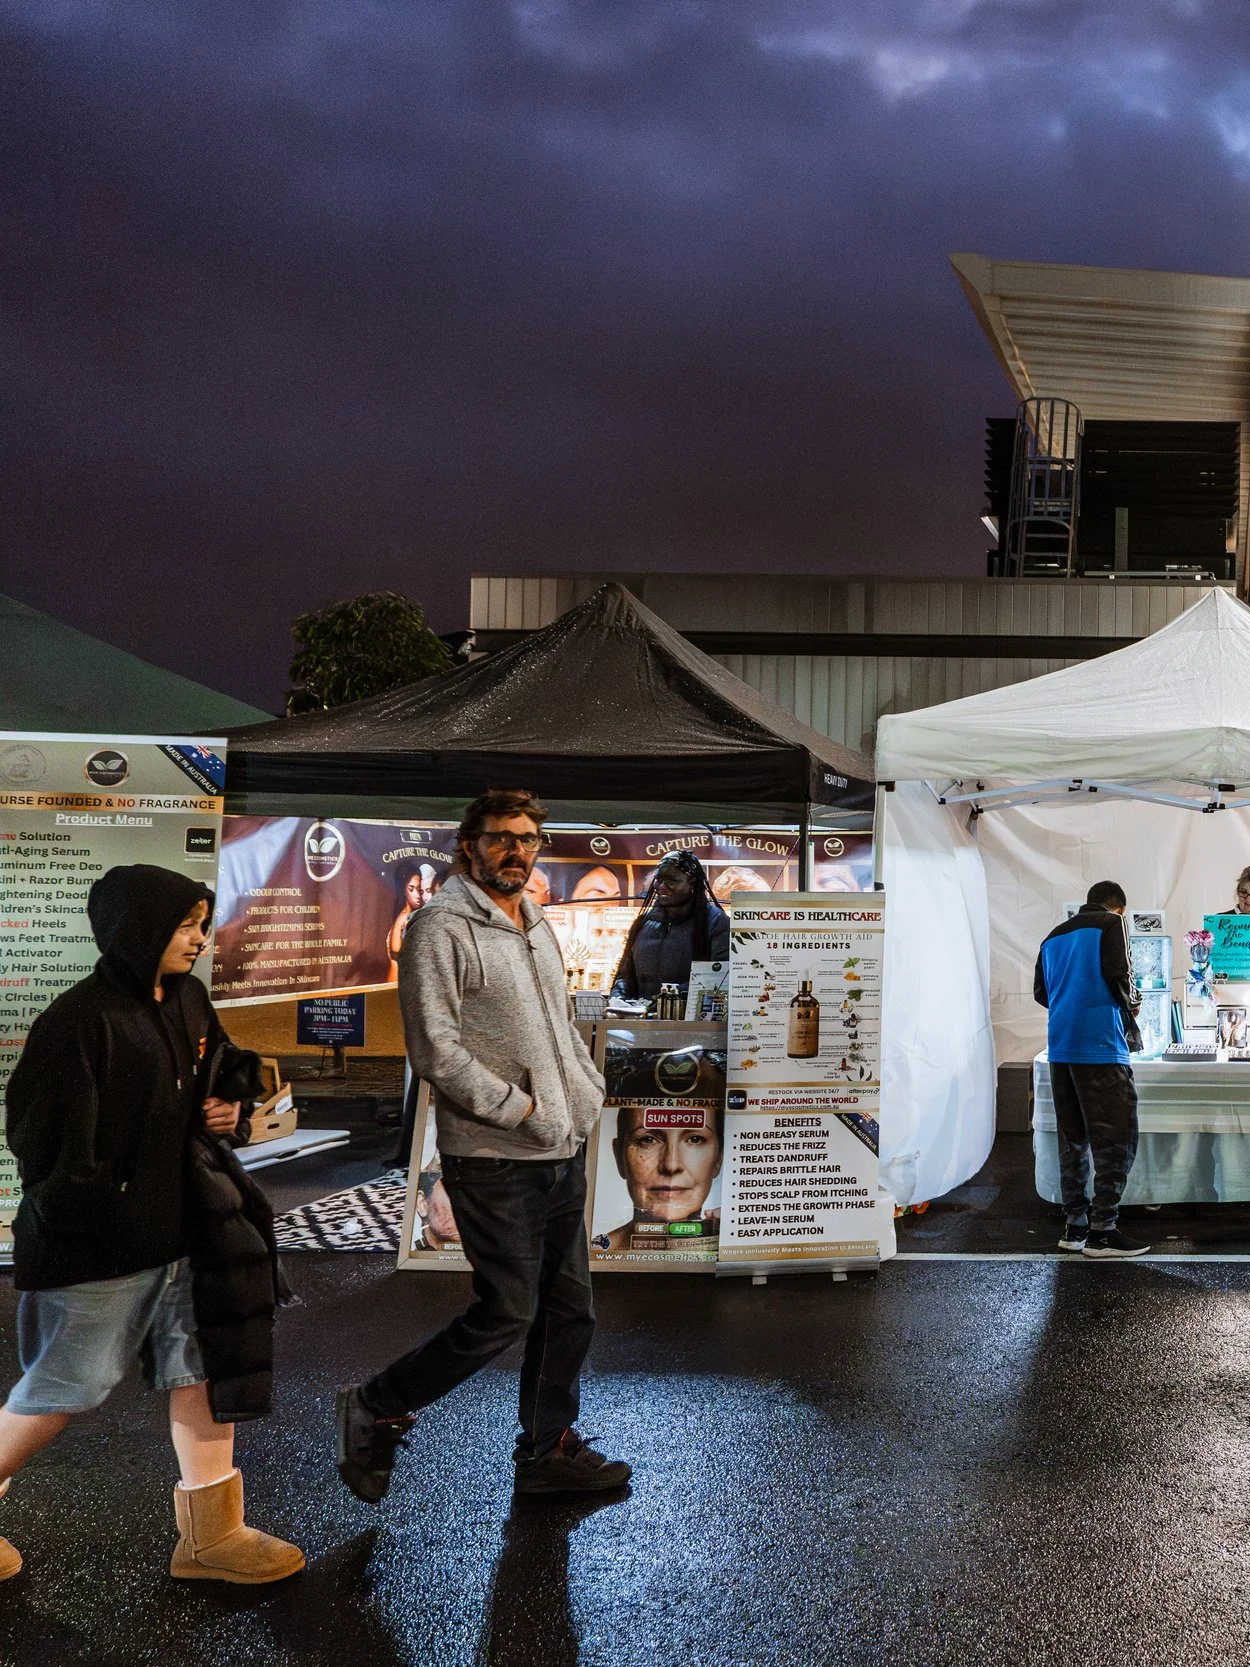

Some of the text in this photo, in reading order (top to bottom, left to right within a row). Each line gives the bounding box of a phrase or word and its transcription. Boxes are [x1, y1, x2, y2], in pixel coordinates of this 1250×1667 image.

[165, 745, 180, 762] MADE
[188, 764, 217, 795] AUSTRALIA
[0, 796, 216, 809] URSE FOUNDED & NO FRAGRANCE
[56, 813, 153, 826] Product Menu
[19, 832, 71, 841] Solution
[646, 835, 789, 857] CAPTURE THE GLOW
[52, 847, 90, 856] Serum
[382, 848, 415, 863] CAPTURE
[416, 847, 428, 857] THE
[0, 861, 103, 870] uminum Free Deo
[30, 876, 64, 884] Razor
[67, 876, 98, 885] Bum
[0, 890, 88, 901] ghtening Deod
[280, 906, 293, 914] FOR
[734, 911, 881, 921] SKINCARE IS HEALTHCARE
[0, 919, 66, 928] cked Heels
[19, 934, 45, 942] Feet
[1228, 930, 1244, 938] the
[276, 941, 289, 950] FOR
[291, 940, 303, 949] THE
[323, 938, 348, 947] FAMILY
[5, 948, 63, 957] Activator
[12, 964, 38, 972] Hair
[0, 978, 30, 987] druff
[232, 980, 251, 989] Meets
[253, 978, 287, 987] Innovation
[5, 993, 47, 1002] Circles
[325, 999, 349, 1007] PUBLIC
[676, 1099, 690, 1107] NO
[693, 1099, 719, 1107] FRAG
[648, 1114, 703, 1123] SUN SPOTS
[774, 1118, 822, 1127] BENEFITS
[763, 1131, 798, 1139] GREASY
[799, 1130, 829, 1138] SERUM
[856, 1127, 877, 1150] AUSTRALIA
[740, 1143, 781, 1151] REDUCES
[740, 1154, 828, 1163] TREATS DANDRUFF
[740, 1166, 778, 1175] REPAIRS
[780, 1166, 817, 1174] BRITTLE
[739, 1177, 857, 1187] REDUCES HAIR SHEDDING
[738, 1189, 868, 1200] STOPS SCALP FROM ITCHING
[738, 1200, 875, 1213] EXTENDS THE GROWTH PHASE
[738, 1215, 815, 1225] LEAVE-IN SERUM
[638, 1224, 663, 1232] BEFORE
[737, 1227, 824, 1238] EASY APPLICATION
